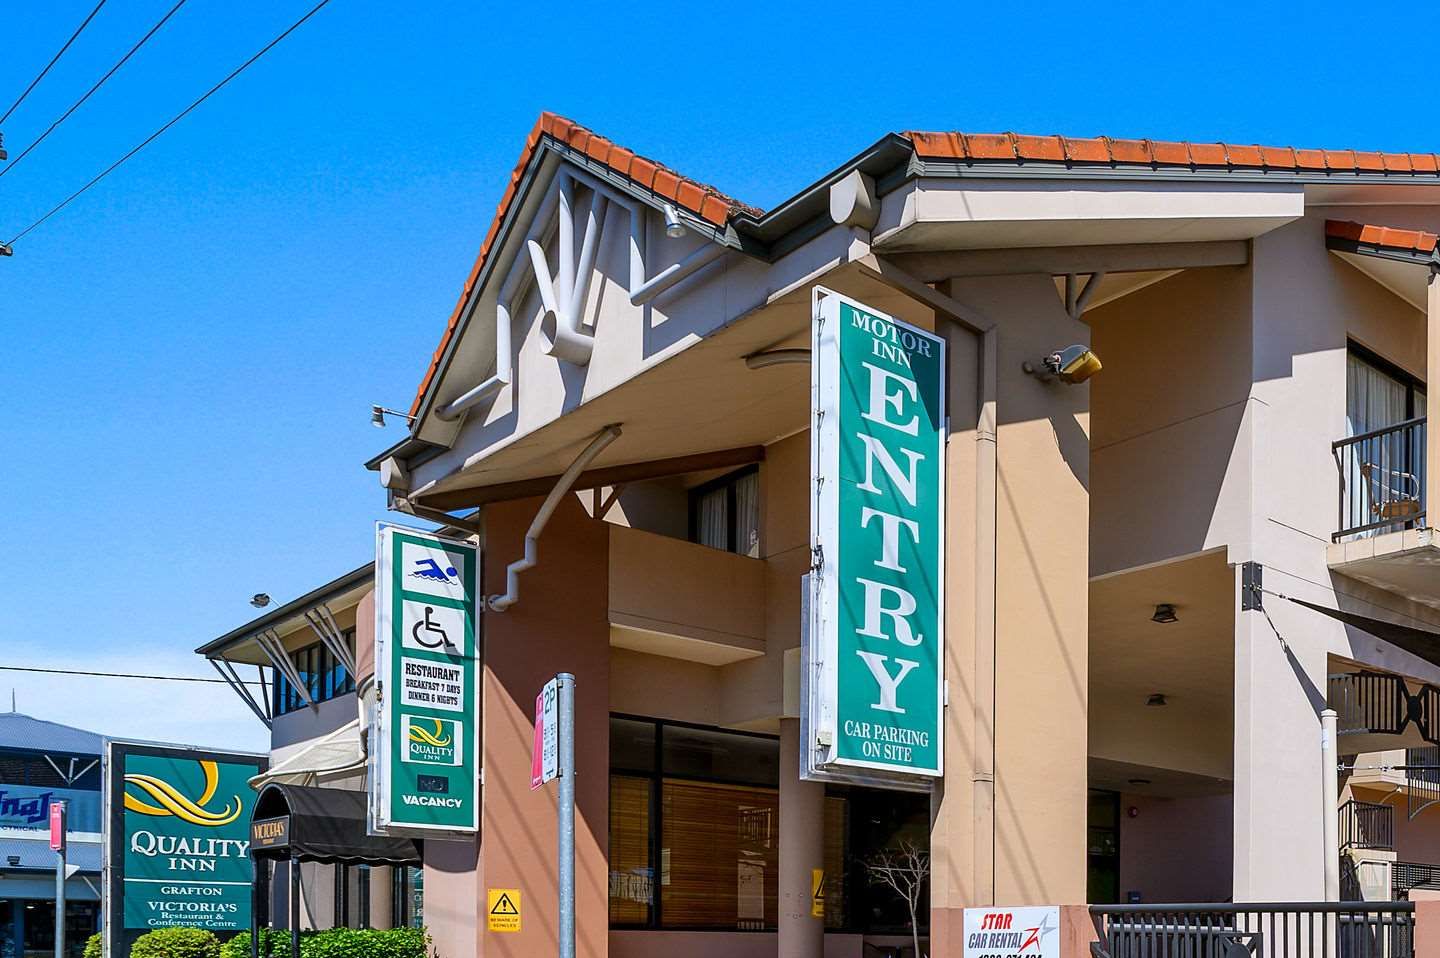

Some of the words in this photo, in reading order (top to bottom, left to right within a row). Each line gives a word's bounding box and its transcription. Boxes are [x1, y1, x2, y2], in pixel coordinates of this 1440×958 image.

[851, 309, 932, 358] MOTOR
[871, 337, 912, 369] INN
[855, 361, 926, 714] ENTRY
[405, 663, 460, 682] RESTAURANT
[406, 678, 440, 692] BREAKFAST
[441, 683, 445, 692] 7
[446, 684, 461, 695] DAYS
[408, 690, 430, 702] DINNER
[431, 694, 435, 703] 6
[436, 694, 458, 706] NIGHTS
[844, 720, 871, 739] CAR
[873, 724, 929, 748] PARKING
[410, 743, 454, 757] QUALITY
[862, 741, 881, 758] ON
[883, 743, 912, 763] SITE
[402, 794, 463, 809] VACANCY
[131, 830, 250, 858] QUALITY
[168, 857, 217, 872] INN
[160, 886, 223, 896] GRAFTON
[147, 901, 238, 913] VICTORIA'S
[161, 911, 214, 920] Restaurant
[147, 918, 203, 927] Conference
[205, 919, 237, 927] Centre
[981, 912, 1013, 930] STAR
[968, 932, 987, 949] CAR
[988, 932, 1023, 949] RENTAL
